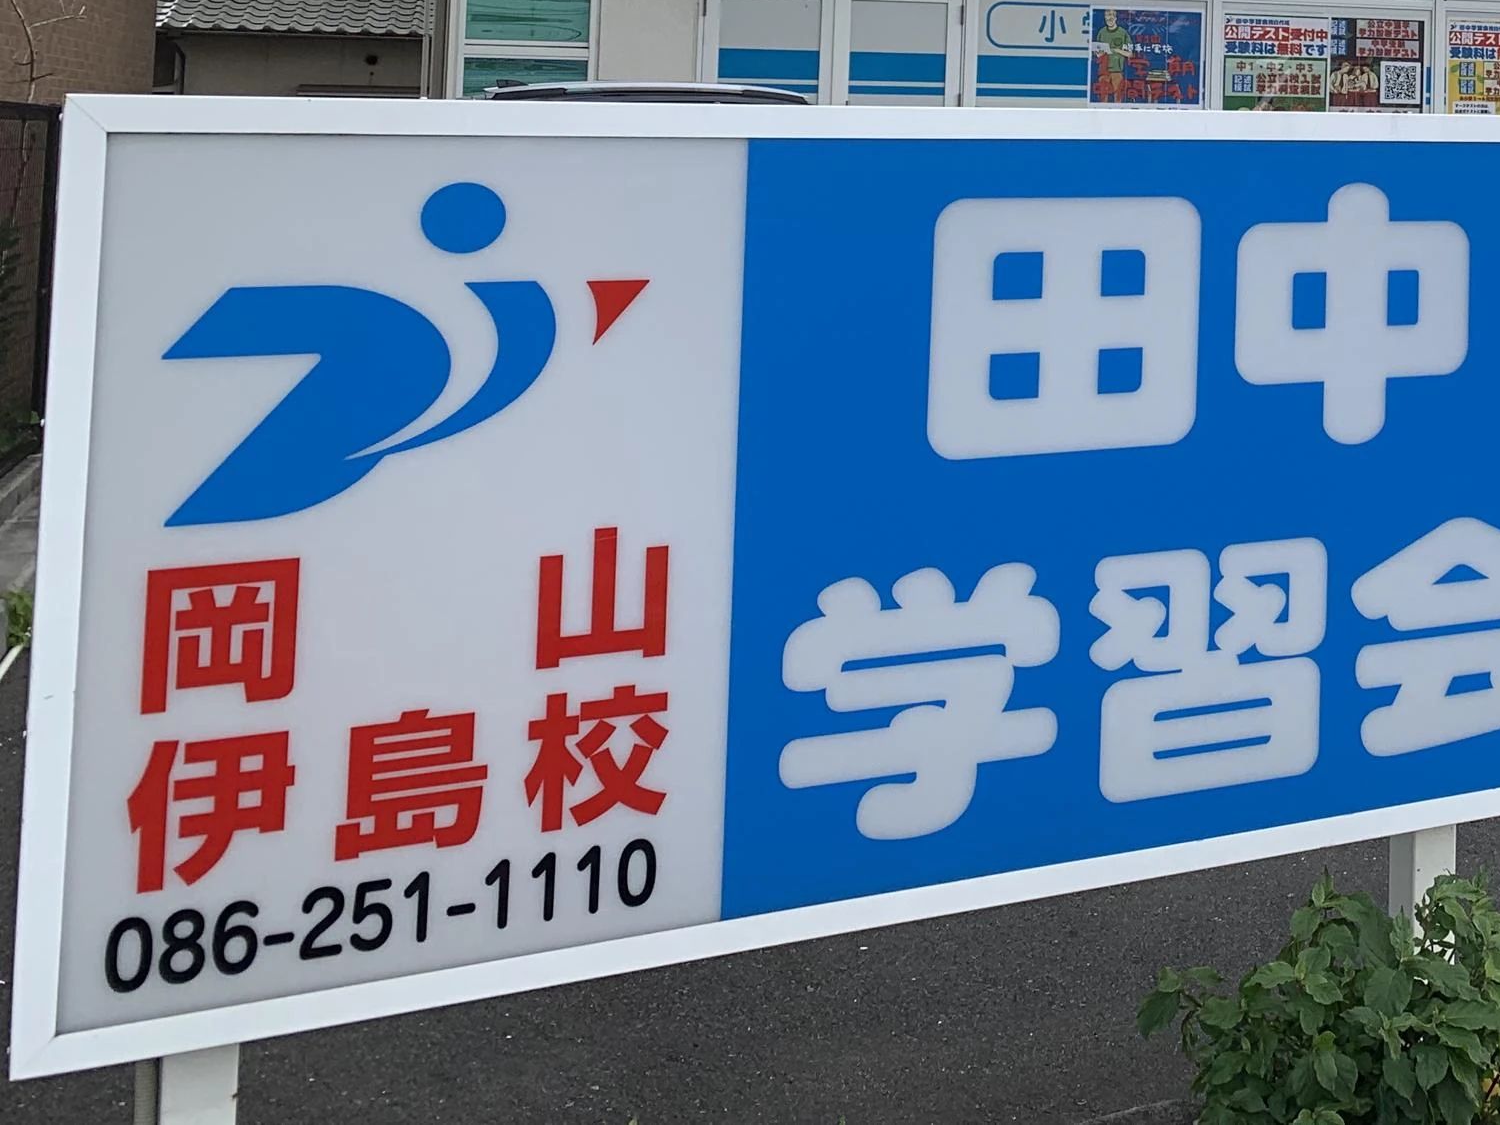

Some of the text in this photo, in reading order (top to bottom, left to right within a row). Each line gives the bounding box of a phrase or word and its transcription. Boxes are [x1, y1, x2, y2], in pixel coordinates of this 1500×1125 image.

[1225, 26, 1328, 42] 公開テスト受付中
[1225, 41, 1328, 56] 受験料は無料です
[926, 182, 1470, 461] 田中
[139, 526, 670, 717] 岡山
[125, 683, 671, 894] 伊島校
[104, 838, 657, 994] 086-251-1110
